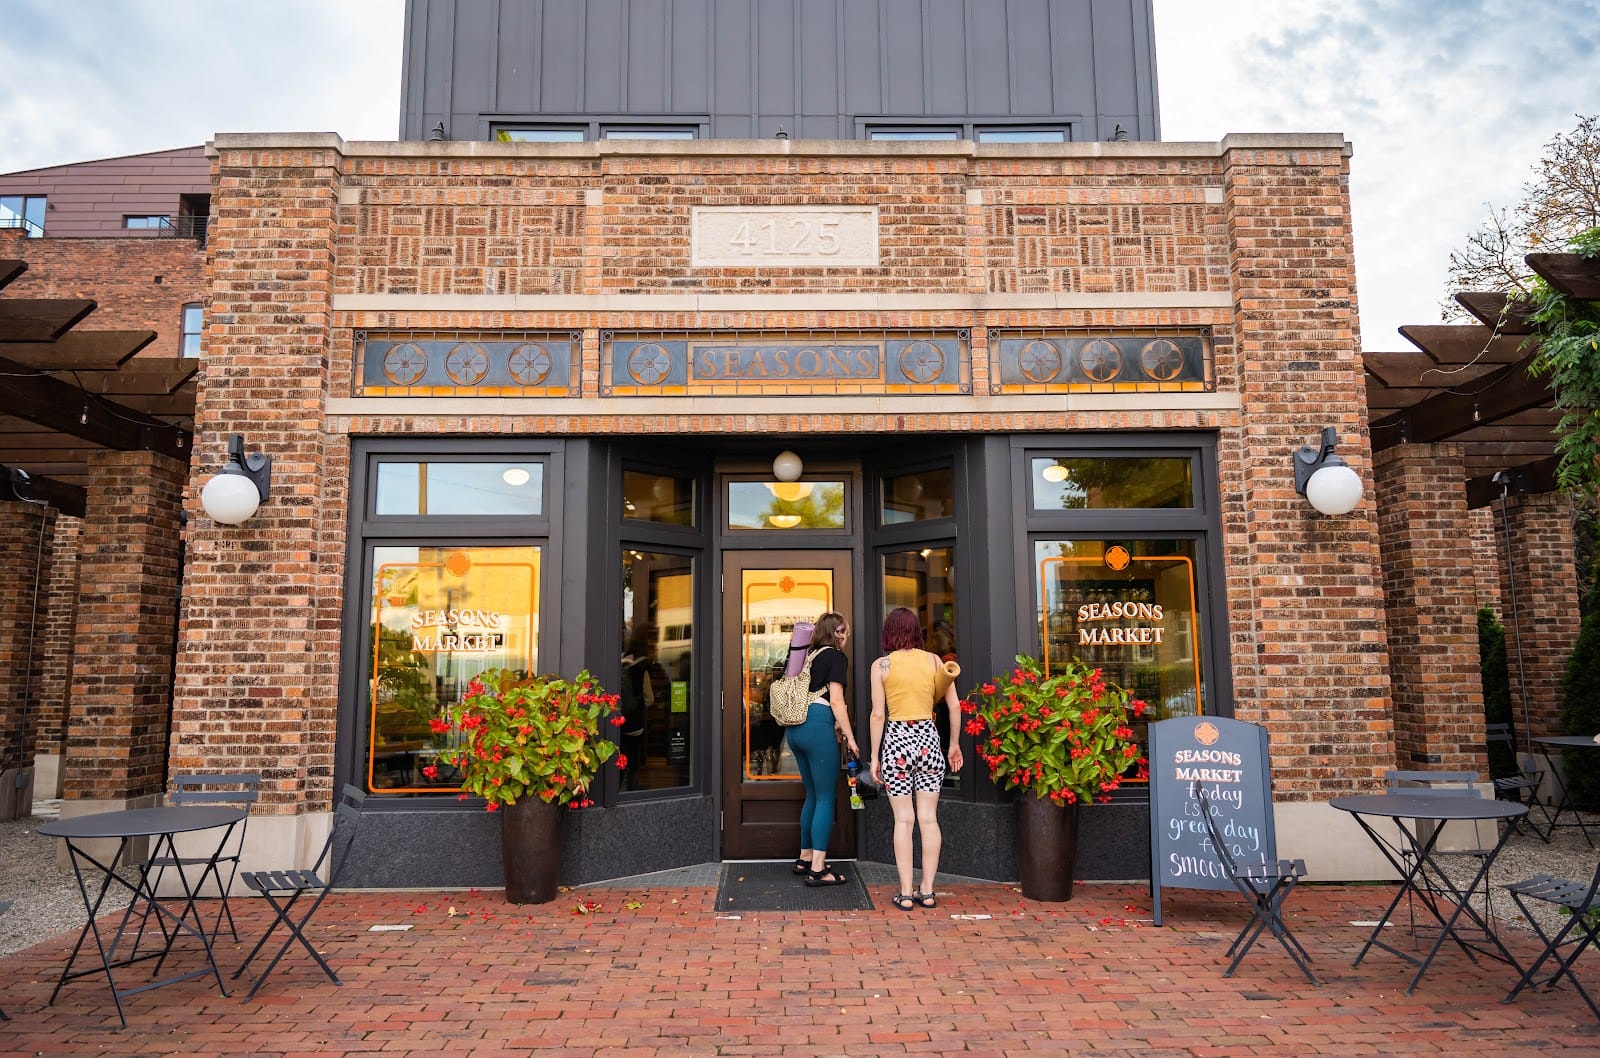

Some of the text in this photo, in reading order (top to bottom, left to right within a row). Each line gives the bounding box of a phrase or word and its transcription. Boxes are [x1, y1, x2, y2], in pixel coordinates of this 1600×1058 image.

[729, 216, 841, 256] 4125
[700, 349, 873, 377] SEASONS
[411, 608, 500, 630] SEASONS
[1077, 601, 1164, 622] SEASONS
[411, 635, 500, 652] MARKET
[1079, 627, 1165, 646] MARKET
[1174, 750, 1242, 766] SEASONS
[1175, 767, 1243, 783] MARKET
[1185, 781, 1242, 810] today
[1184, 801, 1224, 817] is a
[1224, 818, 1260, 851] day
[1233, 844, 1246, 857] a
